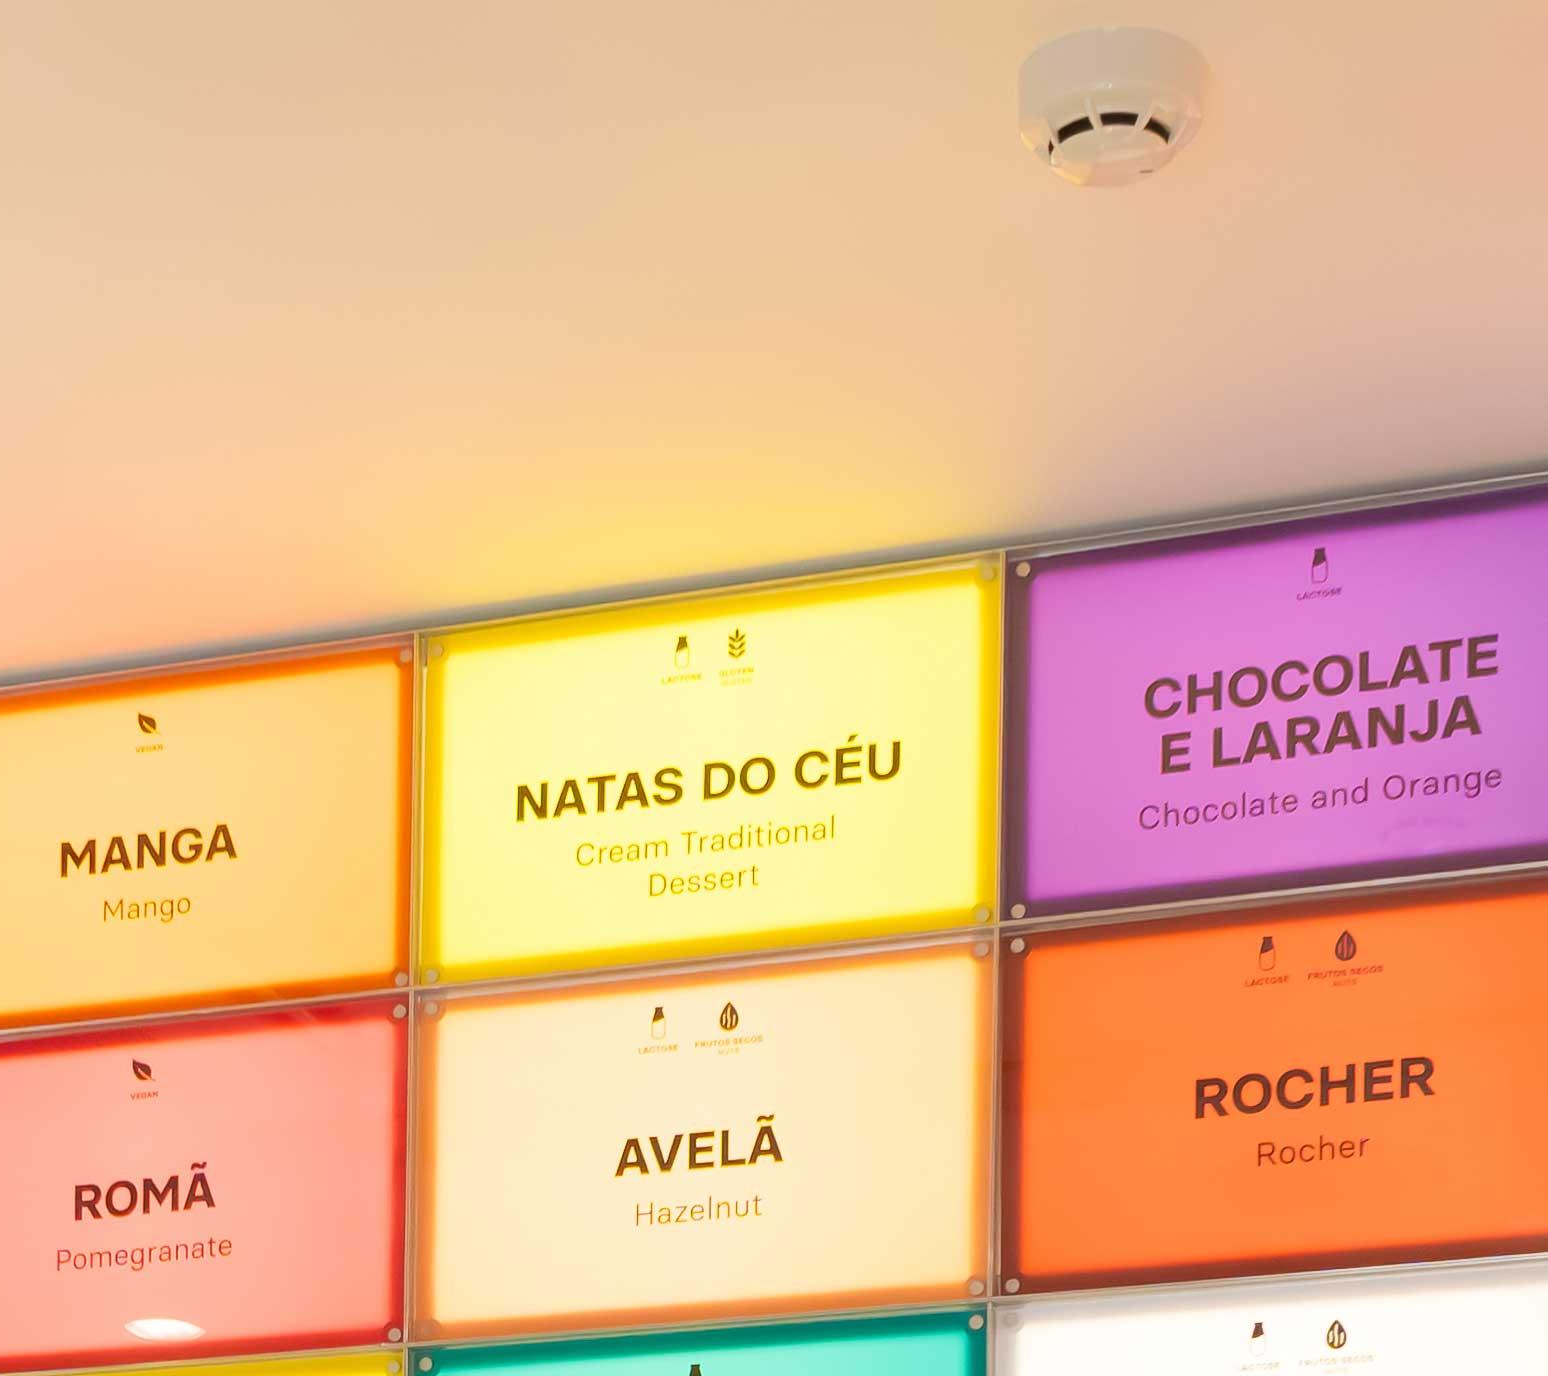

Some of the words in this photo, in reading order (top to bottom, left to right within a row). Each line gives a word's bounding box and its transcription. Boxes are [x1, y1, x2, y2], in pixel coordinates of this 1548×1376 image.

[1145, 634, 1498, 719] CHOCOLATE
[1158, 732, 1191, 774] E
[1211, 696, 1482, 768] LARANJA
[515, 768, 682, 821] NATAS
[701, 757, 775, 800] DO
[795, 735, 900, 791] CÉU
[1138, 792, 1298, 829] Chocolate
[1310, 777, 1368, 809] and
[1381, 763, 1501, 809] Orange
[58, 824, 236, 877] MANGA
[575, 833, 668, 867] Cream
[680, 815, 834, 854] Traditional
[101, 894, 190, 922] Mango
[647, 865, 758, 897] Dessert
[1193, 1057, 1434, 1119] ROCHER
[614, 1115, 782, 1176] AVELÃ
[1255, 1132, 1370, 1166] Rocher
[72, 1162, 215, 1221] ROMÃ
[634, 1193, 761, 1226] Hazelnut
[56, 1235, 232, 1275] Pomegranate
